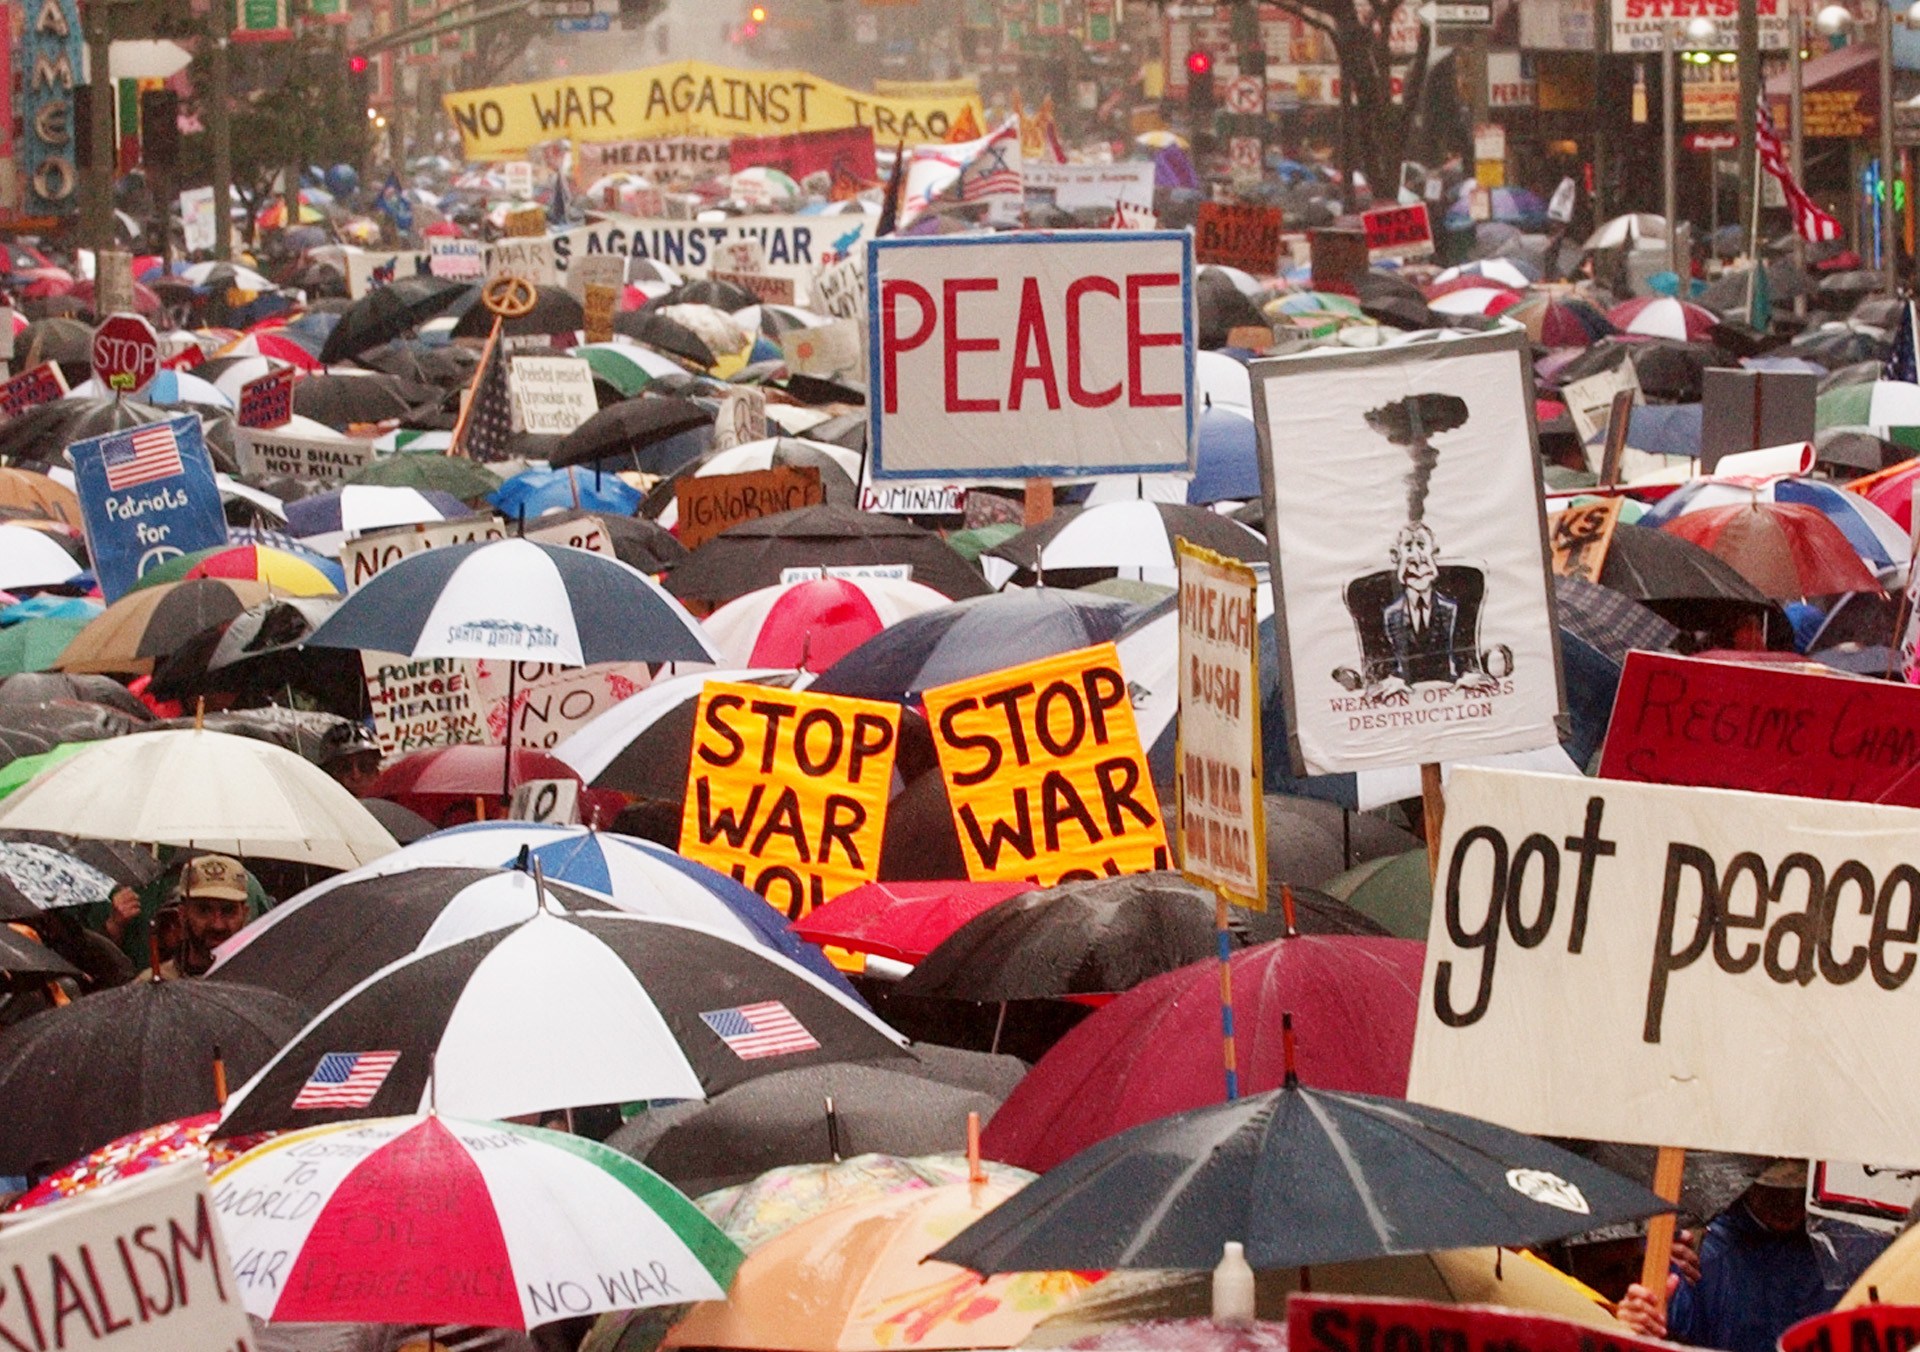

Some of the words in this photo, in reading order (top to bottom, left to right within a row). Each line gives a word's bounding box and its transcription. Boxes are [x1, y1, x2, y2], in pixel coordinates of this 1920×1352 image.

[1626, 0, 1777, 18] STETSN
[452, 100, 504, 140] NO
[531, 86, 616, 131] WAR
[645, 74, 816, 123] AGAINST
[587, 228, 728, 267] AGAINST
[94, 335, 159, 375] STOP
[882, 272, 1183, 414] PEACE
[252, 442, 301, 460] THOU
[306, 448, 364, 467] SHALT
[265, 459, 301, 475] NOT
[106, 487, 188, 522] Patriots
[136, 522, 171, 546] for
[1192, 654, 1240, 721] BUSH
[1330, 690, 1411, 713] WEAPON
[1423, 687, 1450, 704] OF
[519, 689, 594, 732] NO
[939, 667, 1125, 785] STOP
[1349, 703, 1493, 732] DESTRUCTION
[698, 693, 894, 783] STOP
[696, 776, 867, 870] WAR
[958, 757, 1156, 871] WAR
[1434, 796, 1616, 1028] got
[1643, 841, 1920, 1044] peace
[529, 1281, 592, 1317] NO
[601, 1261, 682, 1307] WAR
